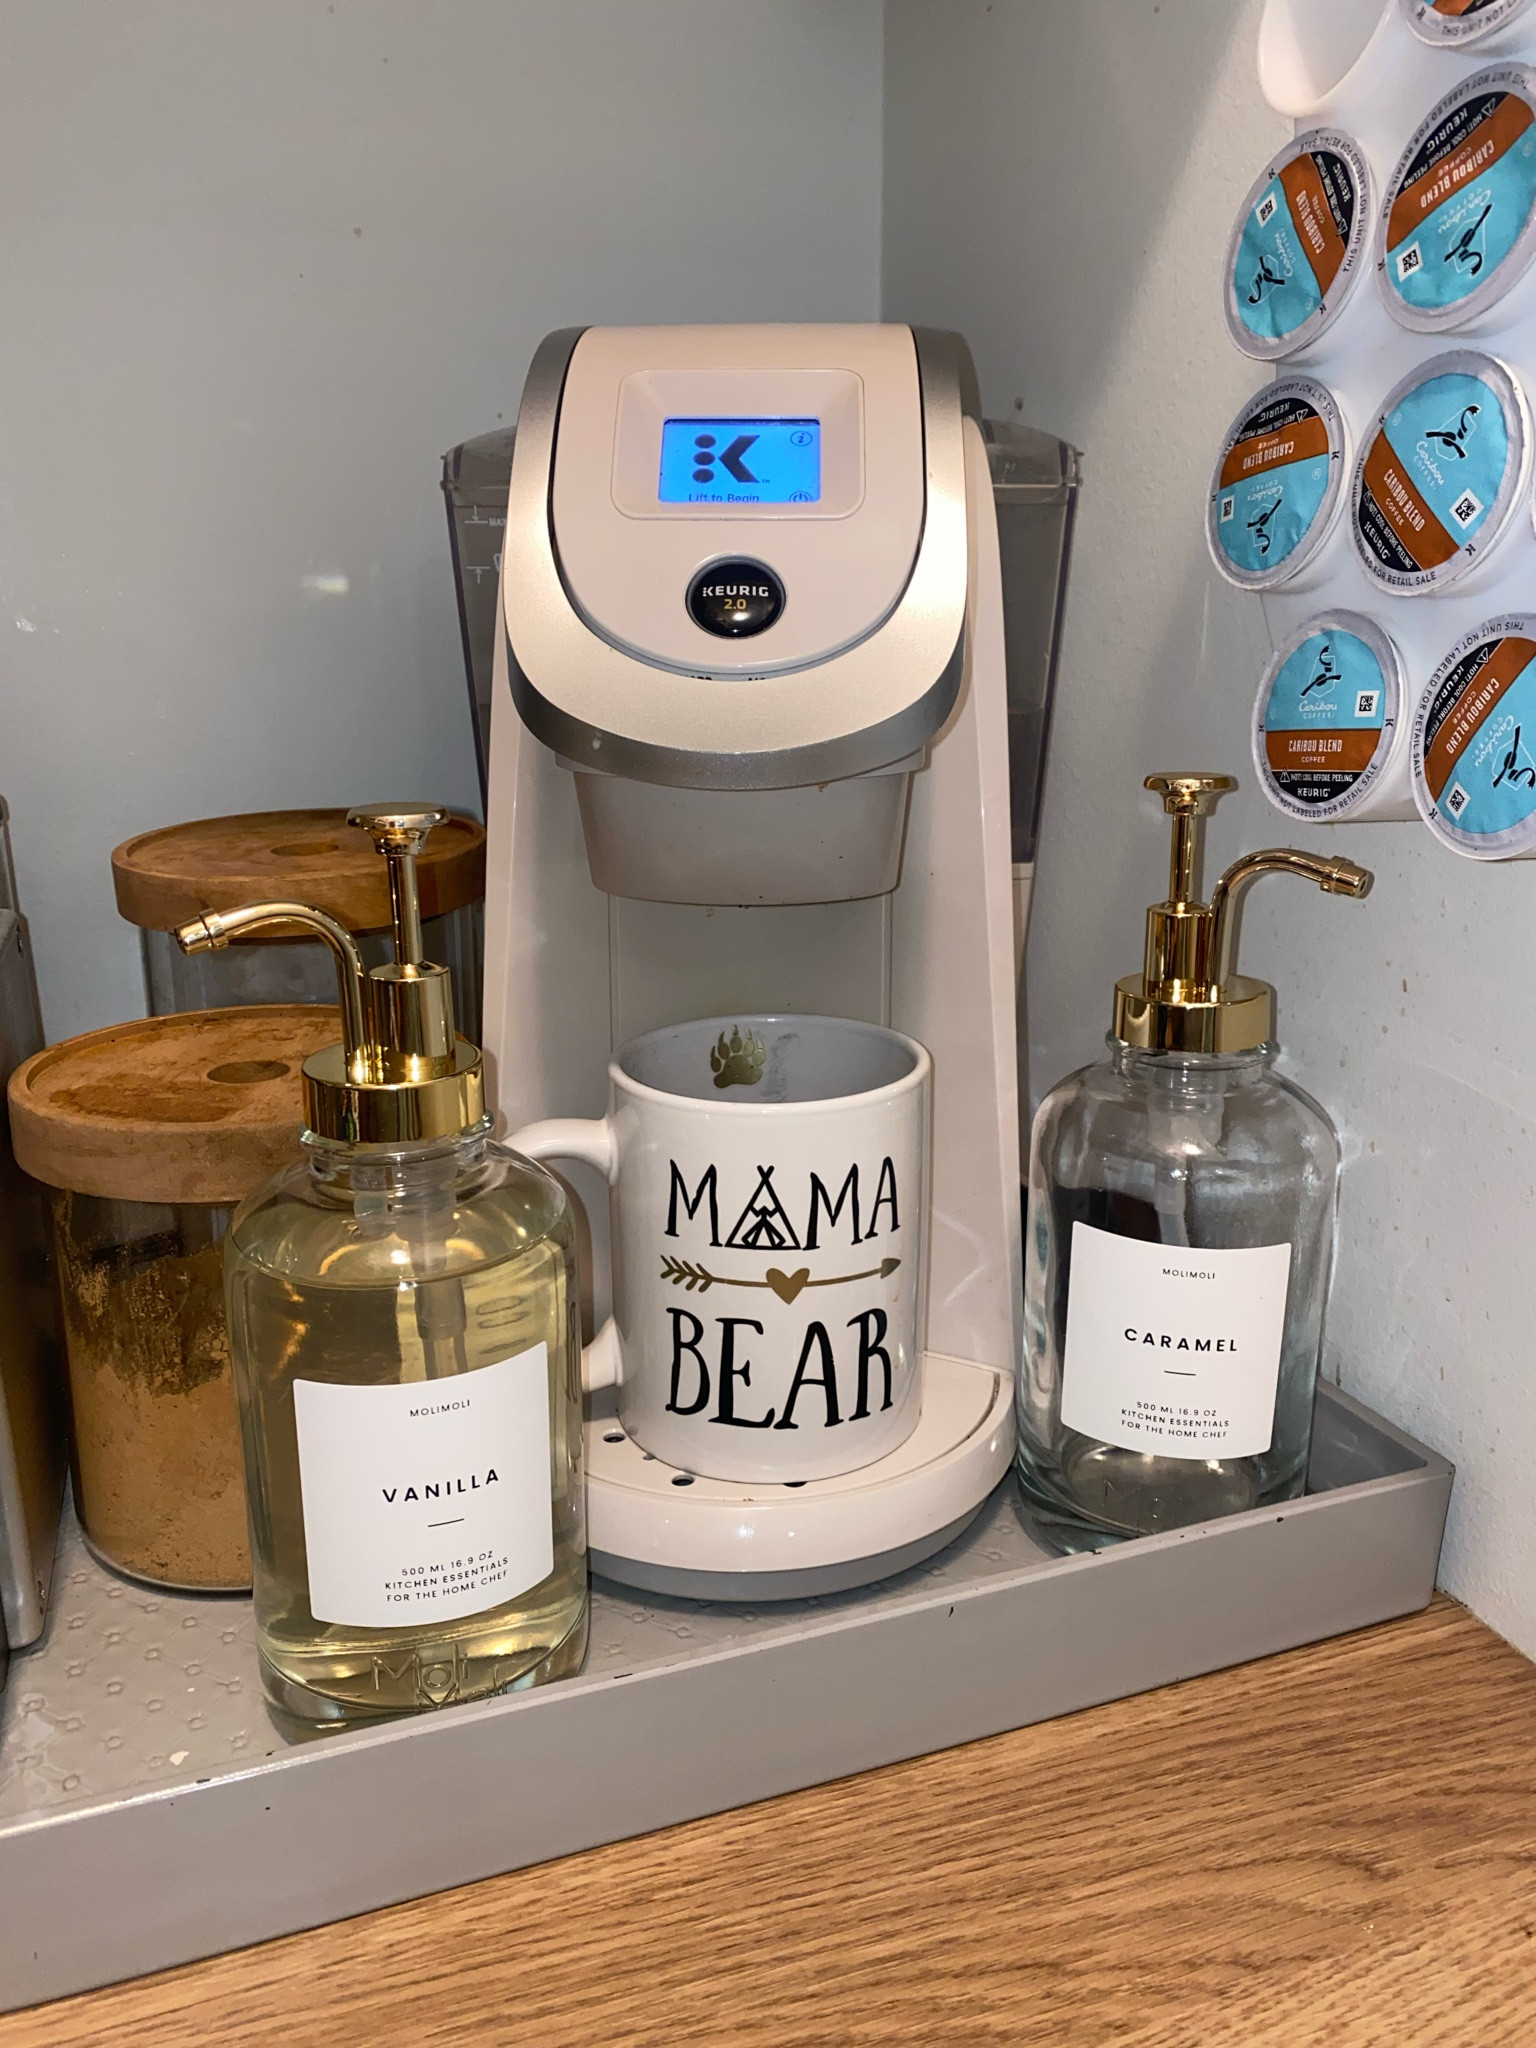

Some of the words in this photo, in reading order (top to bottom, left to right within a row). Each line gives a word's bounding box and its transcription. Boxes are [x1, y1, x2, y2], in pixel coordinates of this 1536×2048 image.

[1453, 140, 1494, 183] CARIBOU
[1420, 175, 1451, 208] BLEND
[1260, 402, 1291, 421] KEURIG
[1264, 441, 1295, 462] CARIBOU
[1416, 441, 1445, 486] Caribou
[688, 493, 709, 503] Lift
[711, 493, 723, 503] to
[727, 493, 760, 503] Begin
[1383, 468, 1409, 507] CARIBOU
[1402, 499, 1426, 532] BLEND
[1385, 498, 1405, 526] COFFEE
[1364, 521, 1389, 559] KEURIG
[1395, 545, 1414, 570] PEELING
[1373, 566, 1386, 580] FOR
[1387, 575, 1414, 587] RETAIL
[1415, 571, 1437, 585] SALE
[702, 585, 769, 597] KEURIG
[723, 598, 747, 610] 2.0
[1482, 623, 1502, 637] UNIT
[1505, 621, 1525, 631] THIS
[1462, 633, 1479, 650] NOT
[1430, 647, 1461, 687] LABELED
[1420, 688, 1433, 711] FOR
[1434, 665, 1465, 710] KEURIG
[1453, 680, 1467, 699] COOL
[1299, 700, 1338, 713] Caribou
[1438, 696, 1456, 720] BEFORE
[1452, 691, 1477, 725] COFFEE
[1466, 677, 1500, 724] CARIBOU
[1413, 713, 1425, 747] RETAIL
[1445, 722, 1470, 754] BLEND
[1474, 715, 1515, 767] Caribou
[1288, 739, 1317, 753] CARIBOU
[1319, 739, 1343, 752] BLEND
[1413, 752, 1423, 778] SALE
[1292, 805, 1322, 818] LABELED
[1323, 804, 1338, 816] FOR
[1338, 787, 1363, 809] RETAIL
[1362, 762, 1378, 787] SALE
[1331, 773, 1353, 783] PEELING
[1297, 787, 1330, 798] KEURIG
[1162, 1268, 1216, 1280] MOLIMOLI
[1124, 1328, 1238, 1352] CARAMEL
[665, 1307, 894, 1430] BEAR
[409, 1398, 471, 1418] MOLIMOLI
[1121, 1408, 1166, 1424] KITCHEN
[1169, 1418, 1230, 1428] ESSENTIALS
[1136, 1401, 1156, 1412] 500
[1160, 1405, 1174, 1414] ML
[1178, 1407, 1200, 1417] 16.9
[1203, 1409, 1217, 1417] OZ
[1121, 1419, 1141, 1430] FOR
[1145, 1425, 1164, 1435] THE
[1168, 1429, 1198, 1439] HOME
[1202, 1430, 1229, 1439] CHEF
[382, 1468, 499, 1503] VANILLA
[384, 1577, 438, 1590] KITCHEN
[442, 1556, 509, 1584] ESSENTIALS
[401, 1565, 425, 1577] 500
[429, 1563, 446, 1574] ML
[450, 1556, 474, 1570] 16.9
[478, 1550, 494, 1562] OZ
[386, 1593, 410, 1602] FOR
[415, 1589, 438, 1600] THE
[442, 1581, 477, 1596] HOME
[480, 1569, 509, 1586] CHEF
